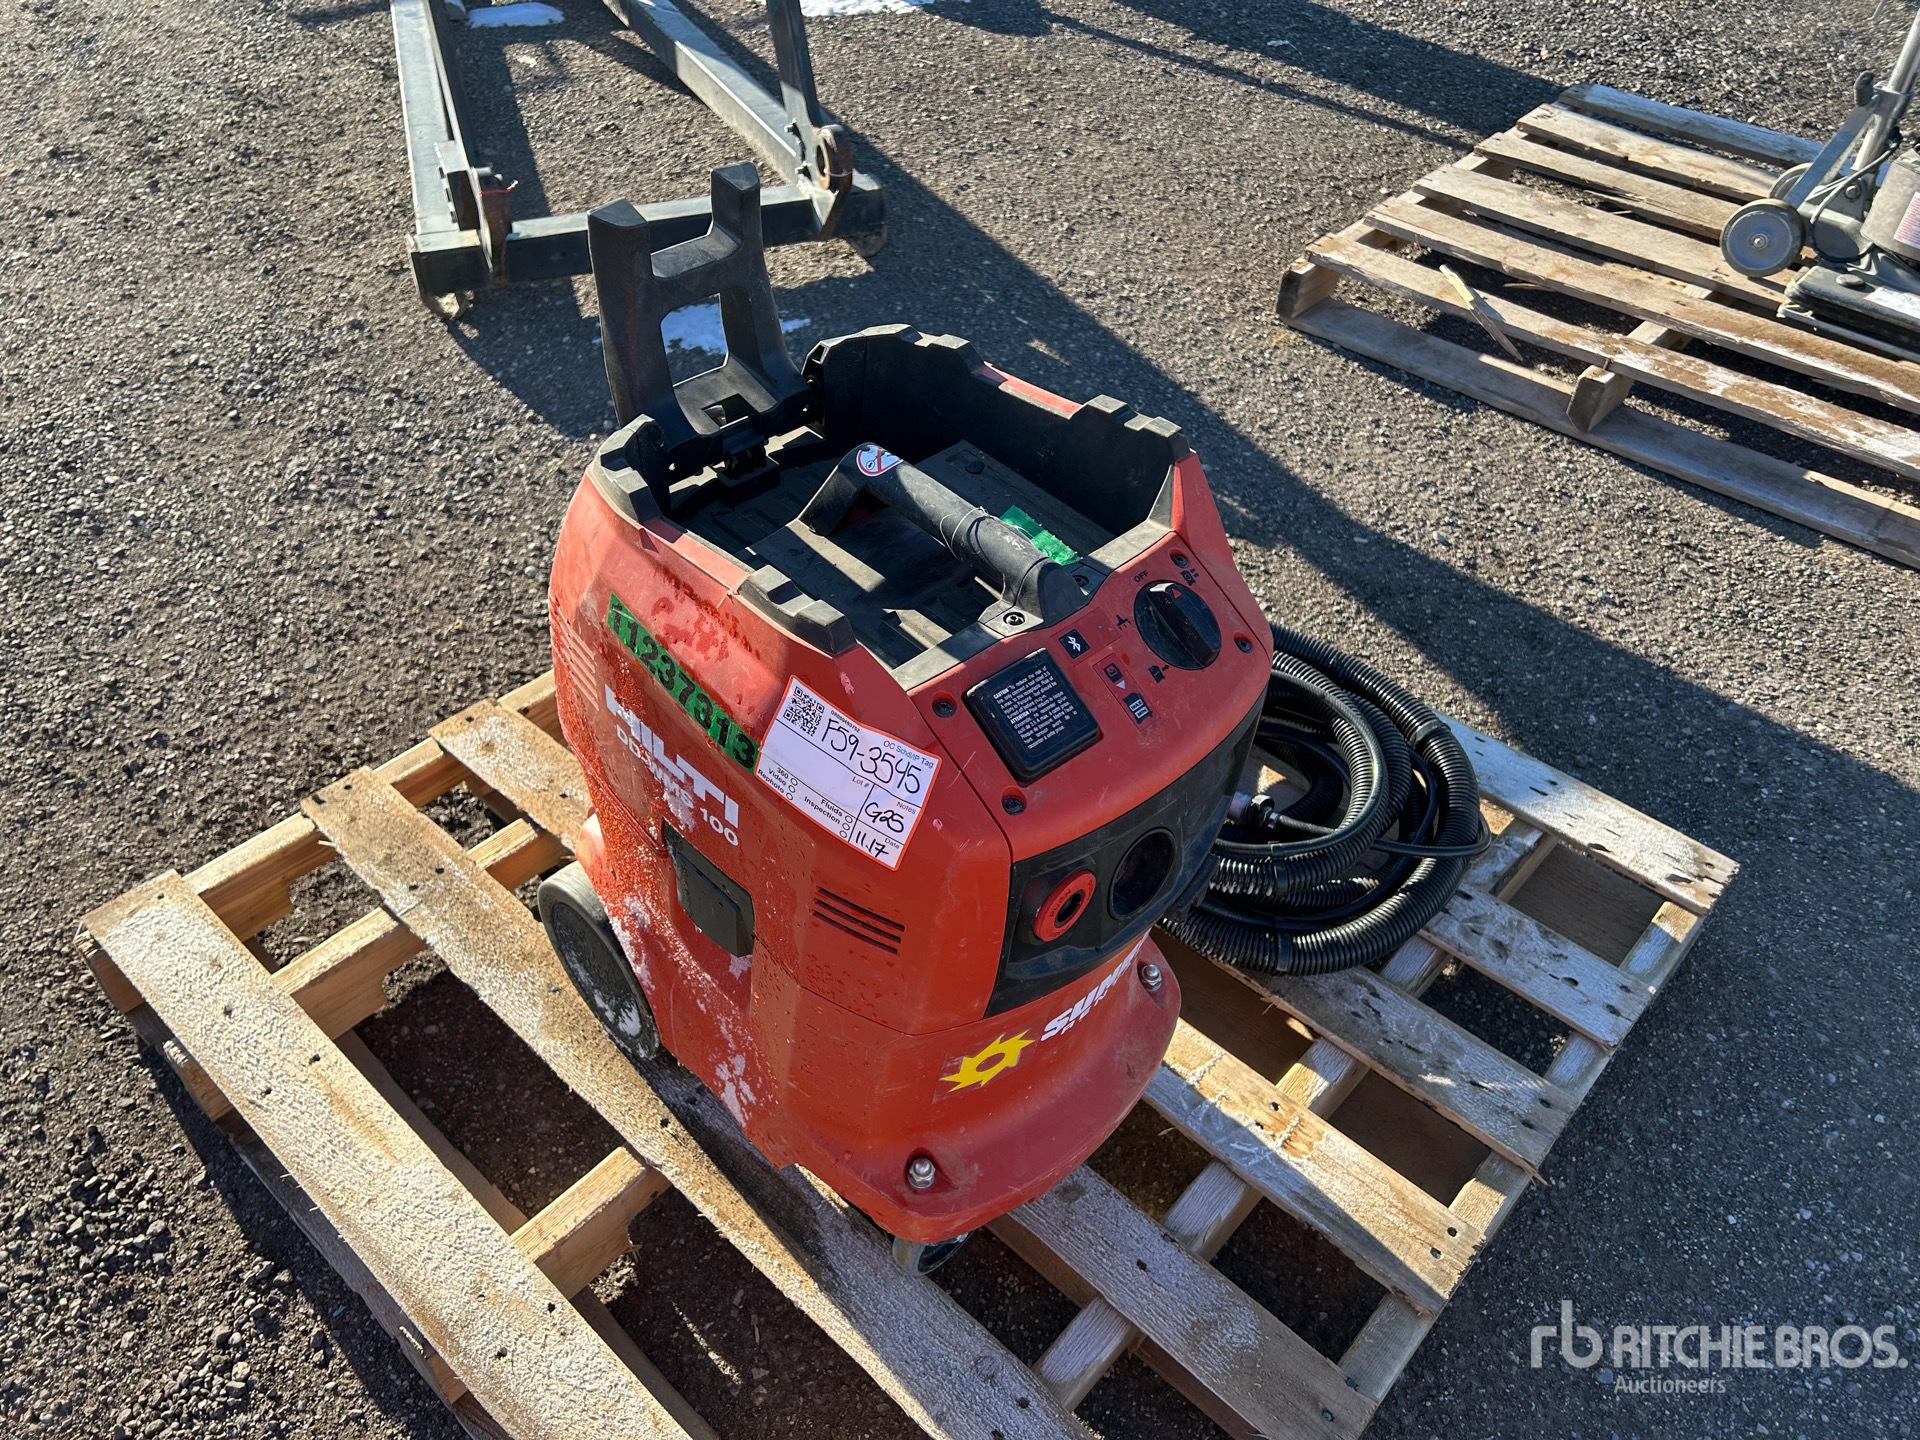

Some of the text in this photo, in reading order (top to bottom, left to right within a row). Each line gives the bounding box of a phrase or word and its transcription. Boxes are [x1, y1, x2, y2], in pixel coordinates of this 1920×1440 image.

[1133, 570, 1149, 582] OFF
[611, 602, 756, 769] 11237313
[604, 683, 739, 828] HILTI
[821, 718, 922, 794] F59-3545
[883, 740, 896, 750] OC
[921, 757, 935, 769] Tag
[757, 768, 785, 794] Rephoto
[768, 767, 787, 786] Video
[776, 767, 789, 780] 360
[852, 776, 864, 786] Lot
[803, 795, 841, 825] Inspection
[820, 798, 844, 818] Fluids
[864, 801, 905, 833] G25
[896, 801, 917, 815] Notes
[700, 807, 739, 846] 100
[884, 837, 900, 850] Date
